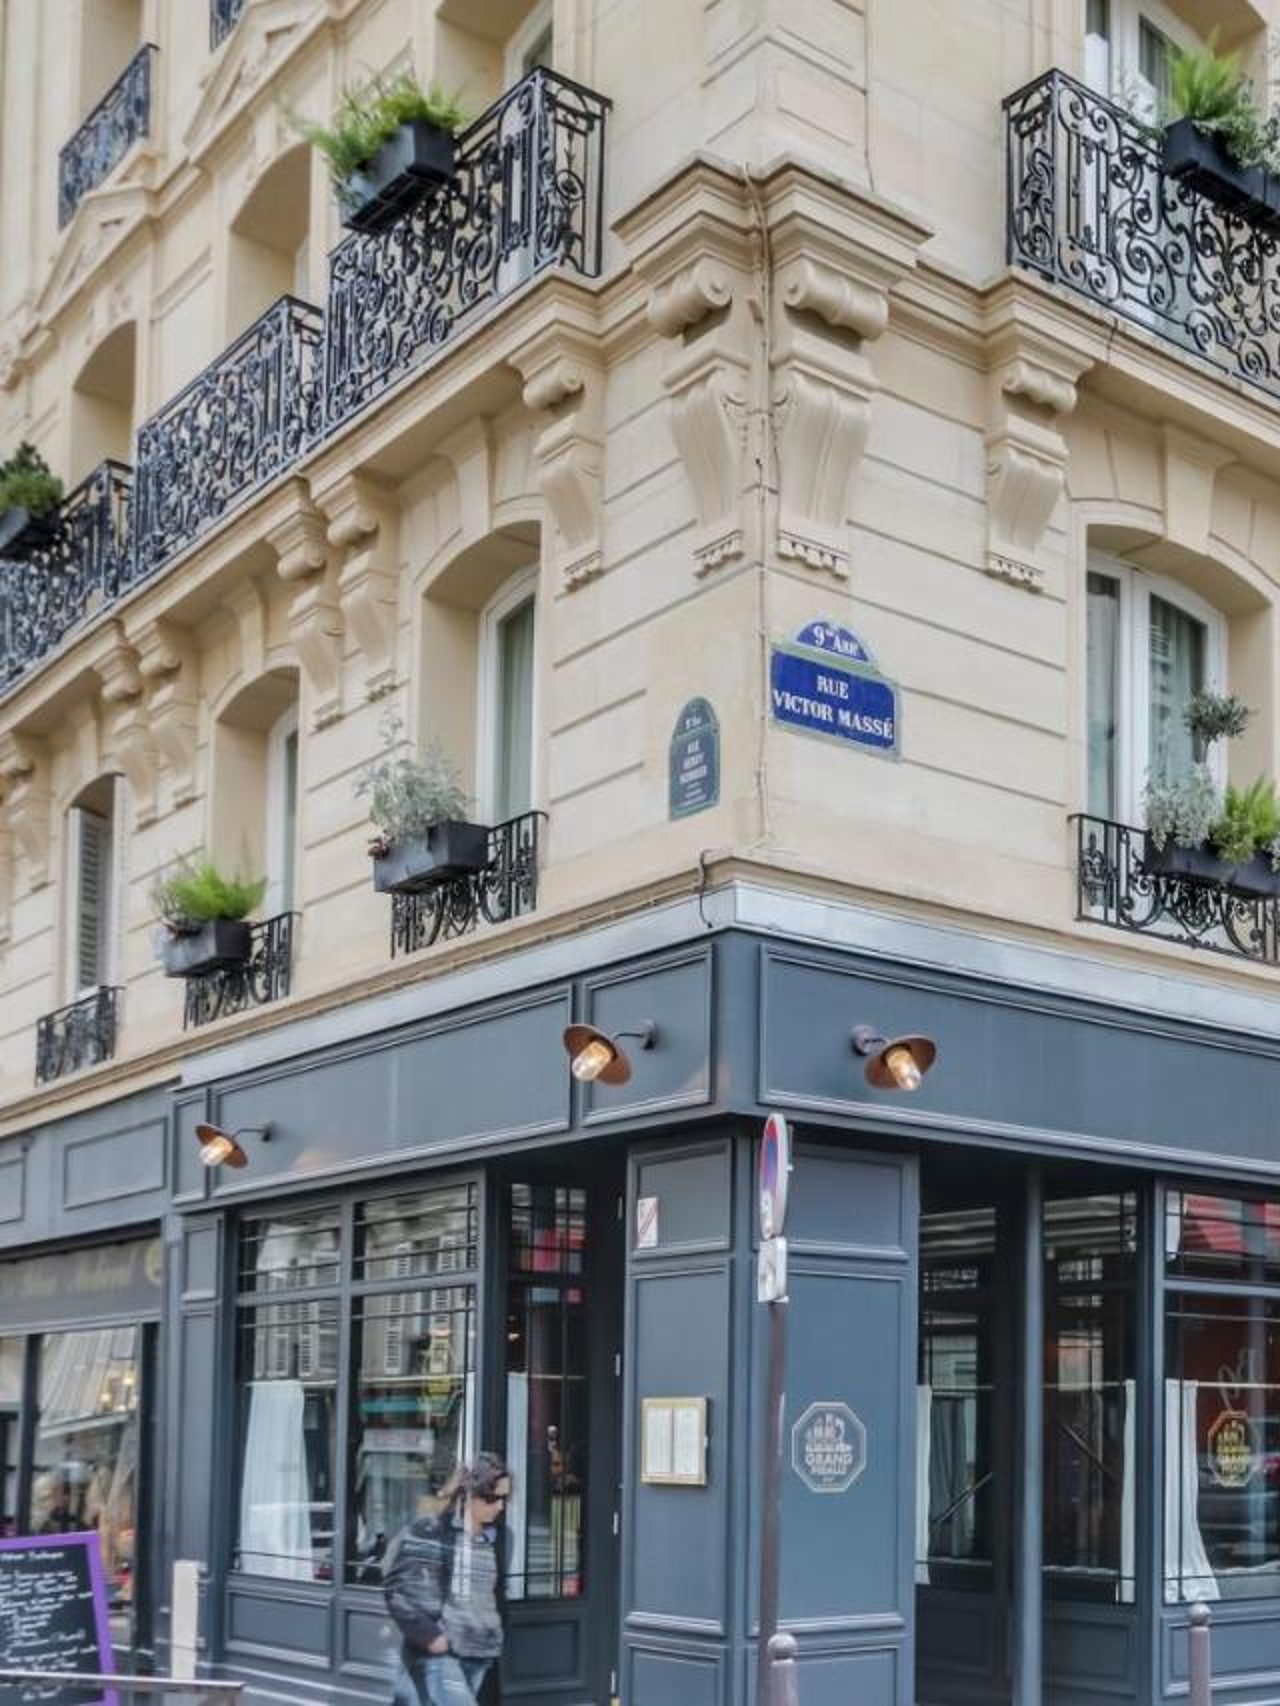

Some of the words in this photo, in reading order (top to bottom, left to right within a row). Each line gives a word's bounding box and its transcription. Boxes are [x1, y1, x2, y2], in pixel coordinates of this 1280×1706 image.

[816, 675, 849, 700] RUE
[772, 689, 834, 723] VICTOR
[837, 708, 894, 740] MASSÉ
